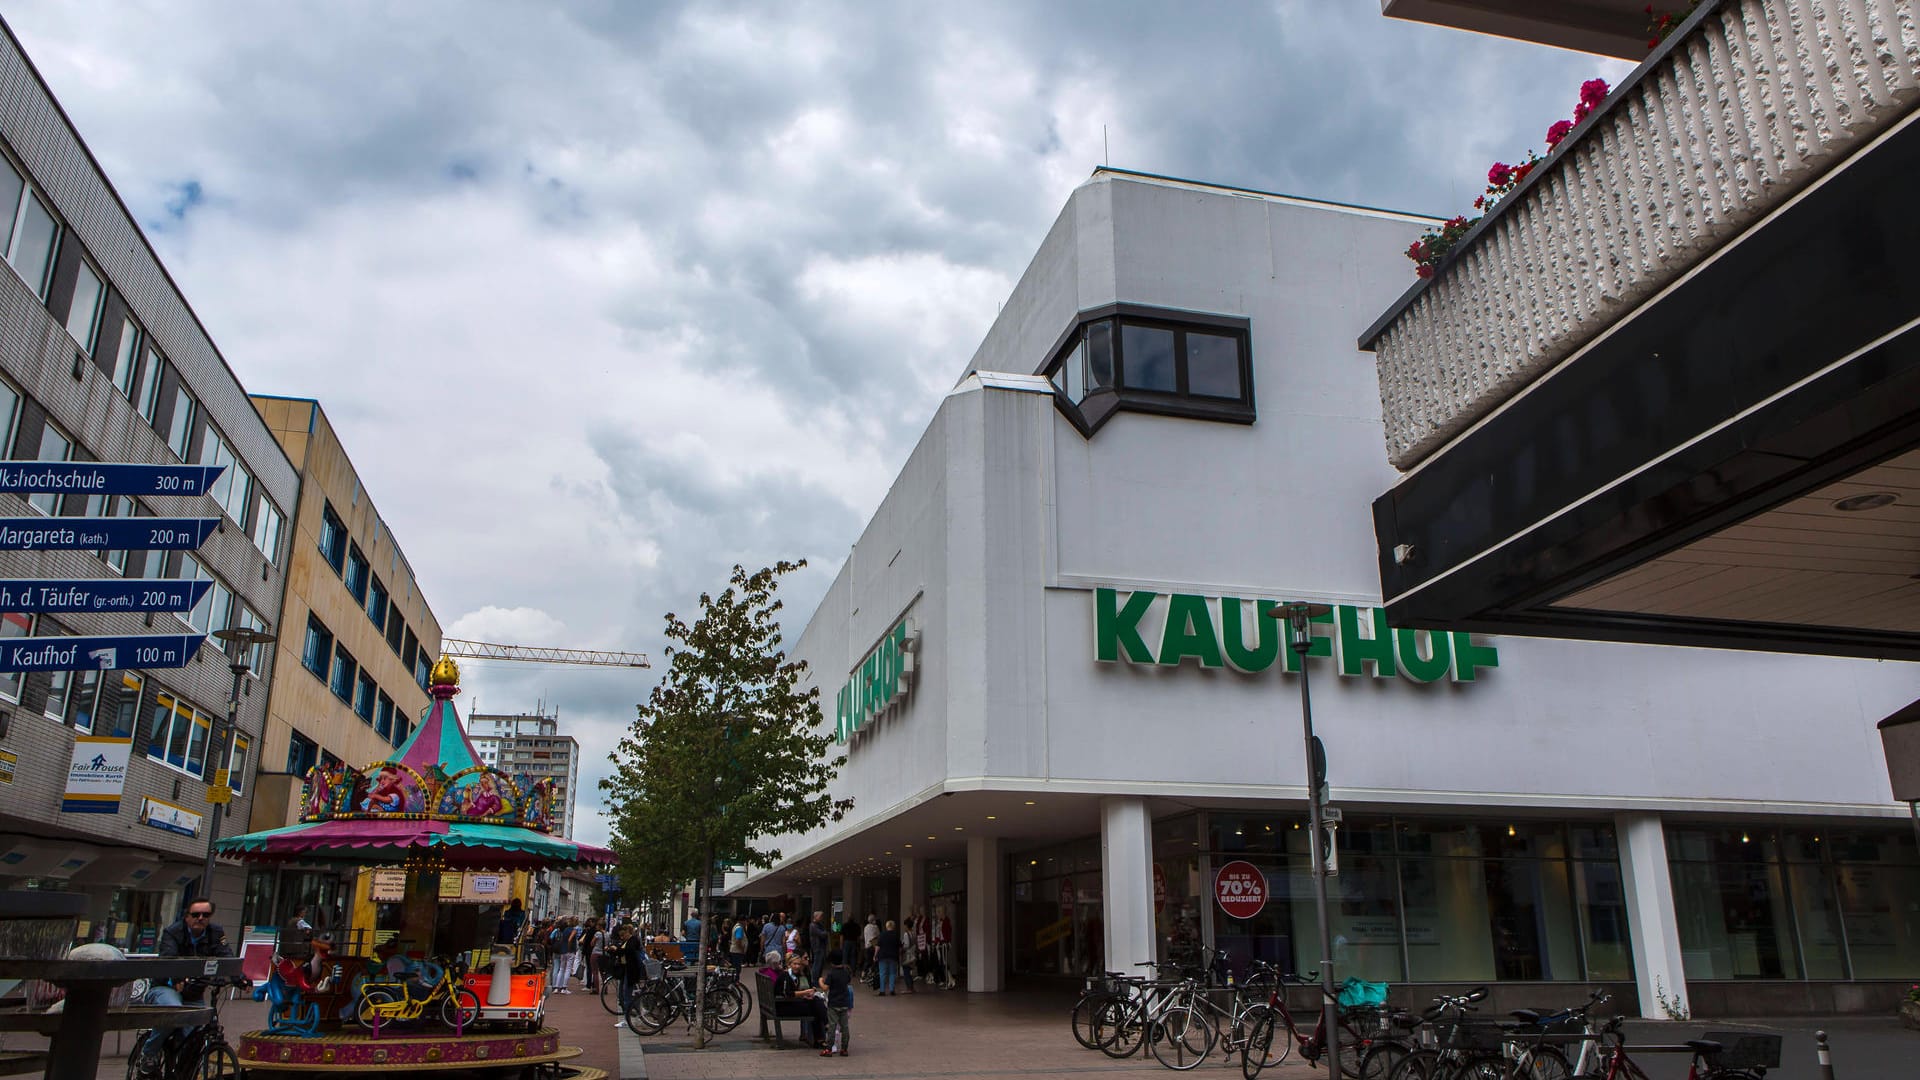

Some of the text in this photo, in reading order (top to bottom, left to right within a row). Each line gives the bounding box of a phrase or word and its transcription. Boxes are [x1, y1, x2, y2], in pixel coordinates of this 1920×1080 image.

[155, 476, 179, 490] 300
[183, 480, 195, 490] m
[79, 533, 109, 546] (kath.)
[149, 530, 174, 544] 200
[178, 533, 190, 544] m
[20, 587, 35, 607] d.
[40, 586, 90, 607] Täufer
[93, 594, 134, 609] (gr.-orth.)
[141, 591, 166, 606] 200
[170, 595, 182, 606] m
[1093, 586, 1499, 683] KAUFHOF
[12, 644, 78, 667] Kaufhof
[135, 647, 159, 664] 100
[163, 651, 175, 663] m
[835, 617, 912, 747] KAUFHOF
[1220, 880, 1262, 895] 70%
[1221, 895, 1262, 903] REDUZIERT
